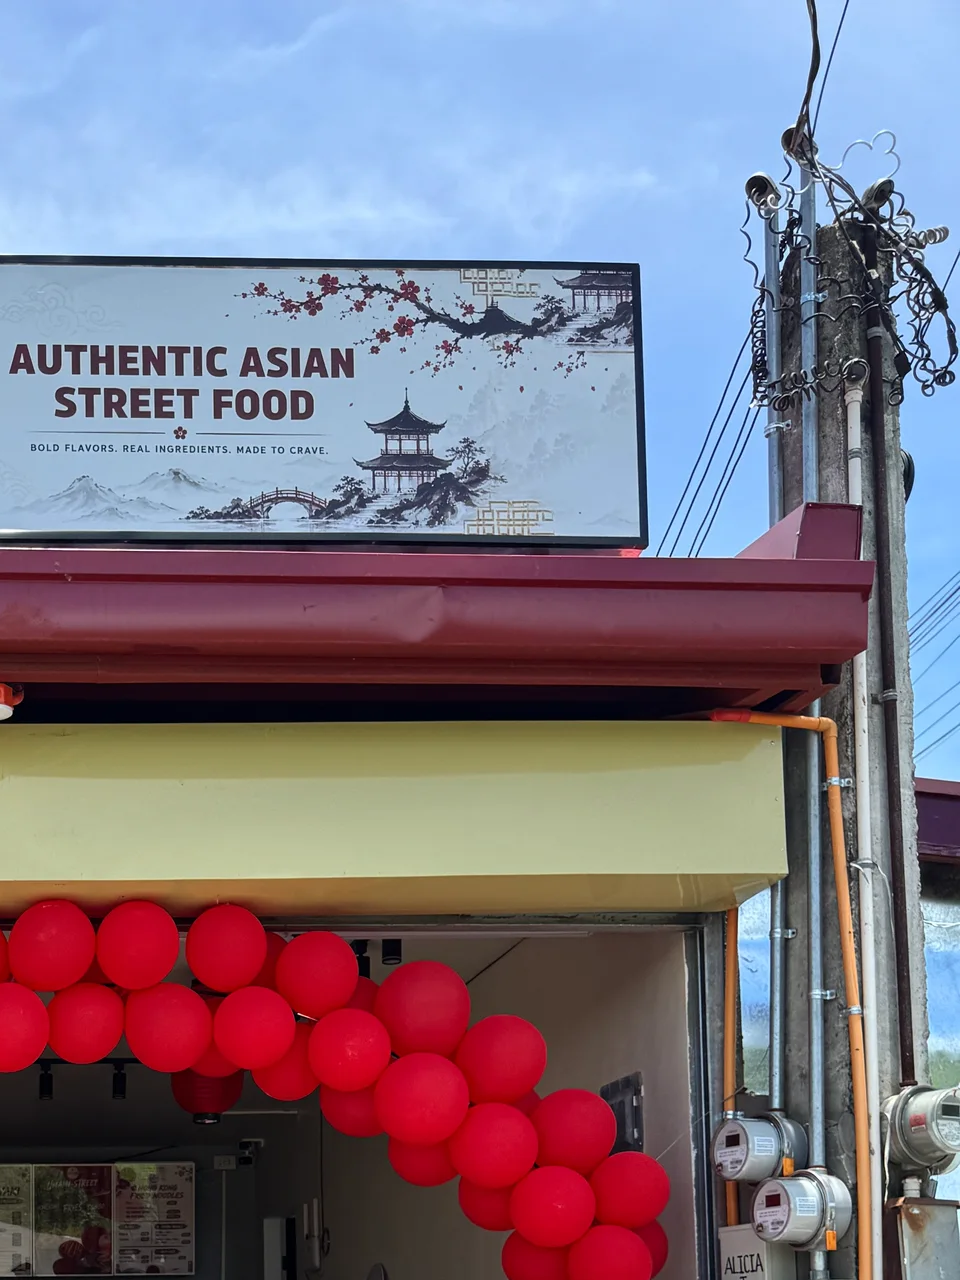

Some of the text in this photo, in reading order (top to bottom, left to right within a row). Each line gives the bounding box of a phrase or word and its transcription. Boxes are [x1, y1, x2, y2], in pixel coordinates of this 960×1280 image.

[9, 343, 355, 379] AUTHENTIC ASIAN
[54, 386, 315, 421] STREET FOOD
[30, 443, 329, 455] BOLD FLAVORS. REAL INGREDIENTS. MADE TO CRAVE.
[724, 1253, 764, 1275] ALICIA
